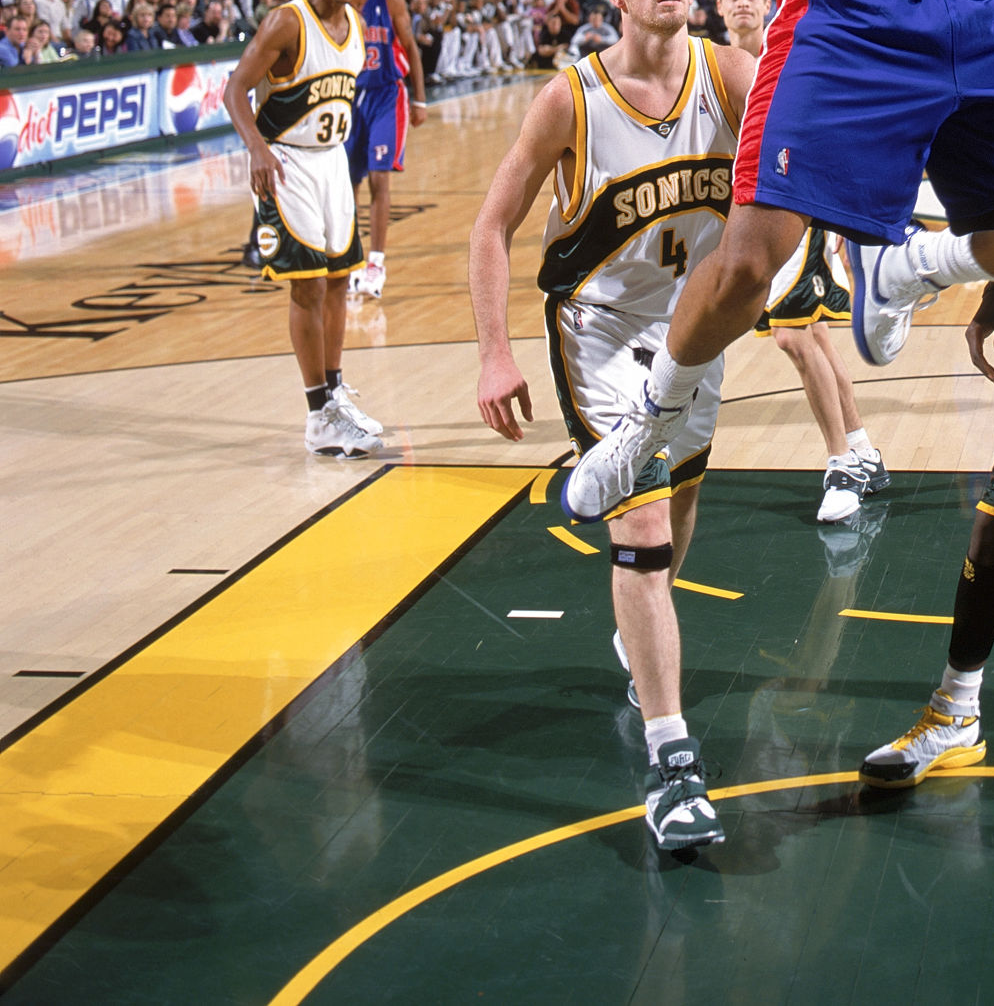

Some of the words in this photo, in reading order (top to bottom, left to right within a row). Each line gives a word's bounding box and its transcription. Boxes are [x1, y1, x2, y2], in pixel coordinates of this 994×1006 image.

[18, 102, 58, 153] diet
[55, 83, 147, 142] PEPSI
[316, 111, 348, 144] 34
[612, 167, 731, 230] SONICS
[659, 226, 688, 280] 4
[812, 274, 825, 298] 8
